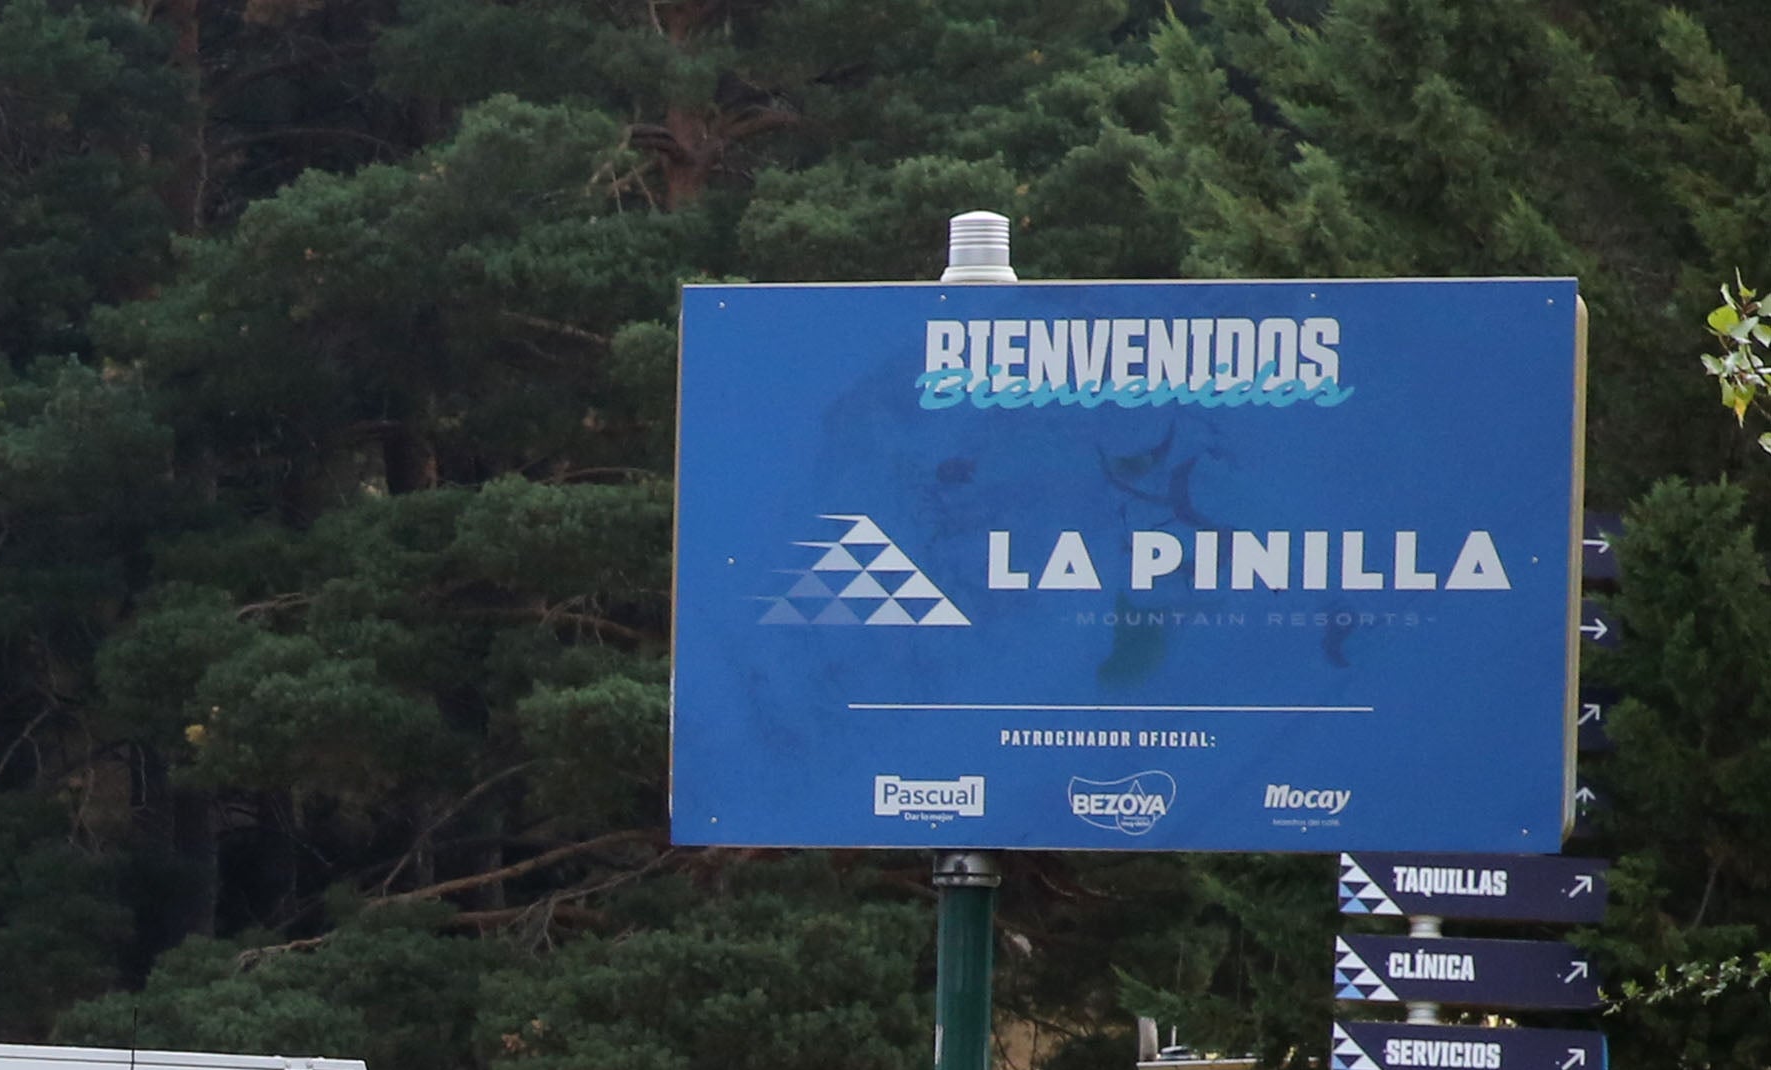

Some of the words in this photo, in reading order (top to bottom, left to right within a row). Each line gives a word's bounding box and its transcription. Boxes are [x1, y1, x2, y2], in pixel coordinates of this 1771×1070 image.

[926, 317, 1341, 393] BIENVENIDOS
[915, 360, 1355, 409] Bienvenidos
[988, 530, 1102, 590] LA
[1131, 530, 1512, 590] PINILLA
[1000, 729, 1131, 747] PATROCINADOR
[1139, 731, 1217, 748] OFICIAL:
[884, 783, 976, 805] Pascual
[1072, 793, 1167, 815] BEZOYA
[1264, 784, 1351, 815] Mocay
[1393, 866, 1508, 897] TAQUILLAS
[1388, 949, 1475, 981] CLÍNICA
[1385, 1039, 1501, 1069] SERVICIOS
